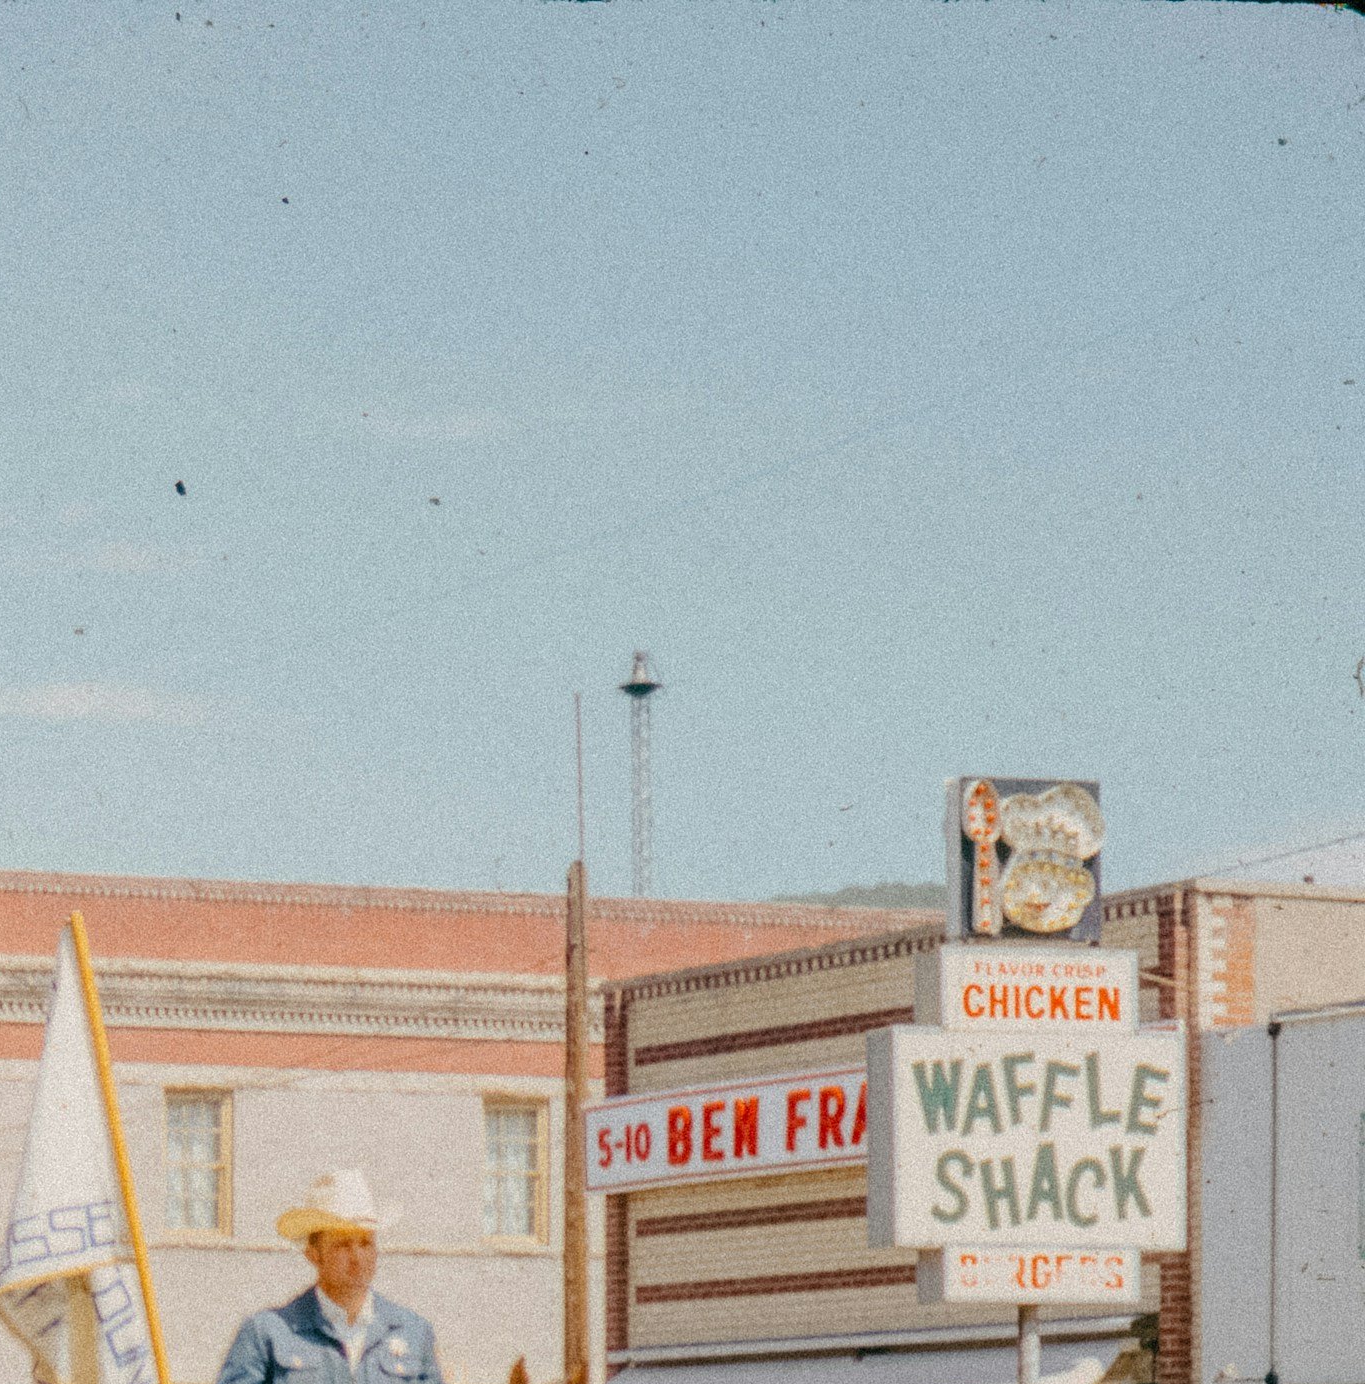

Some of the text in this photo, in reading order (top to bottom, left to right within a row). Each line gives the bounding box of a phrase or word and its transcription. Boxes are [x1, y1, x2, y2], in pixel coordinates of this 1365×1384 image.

[961, 983, 1122, 1022] CHICKEN
[974, 961, 1108, 979] FLAVOR CRISP
[911, 1051, 1171, 1136] WAFFLE
[597, 1121, 653, 1168] 5-10
[667, 1095, 760, 1166] BEN
[930, 1142, 1153, 1231] SHACK
[0, 1200, 117, 1272] SSE
[959, 1252, 1125, 1290] BRGES
